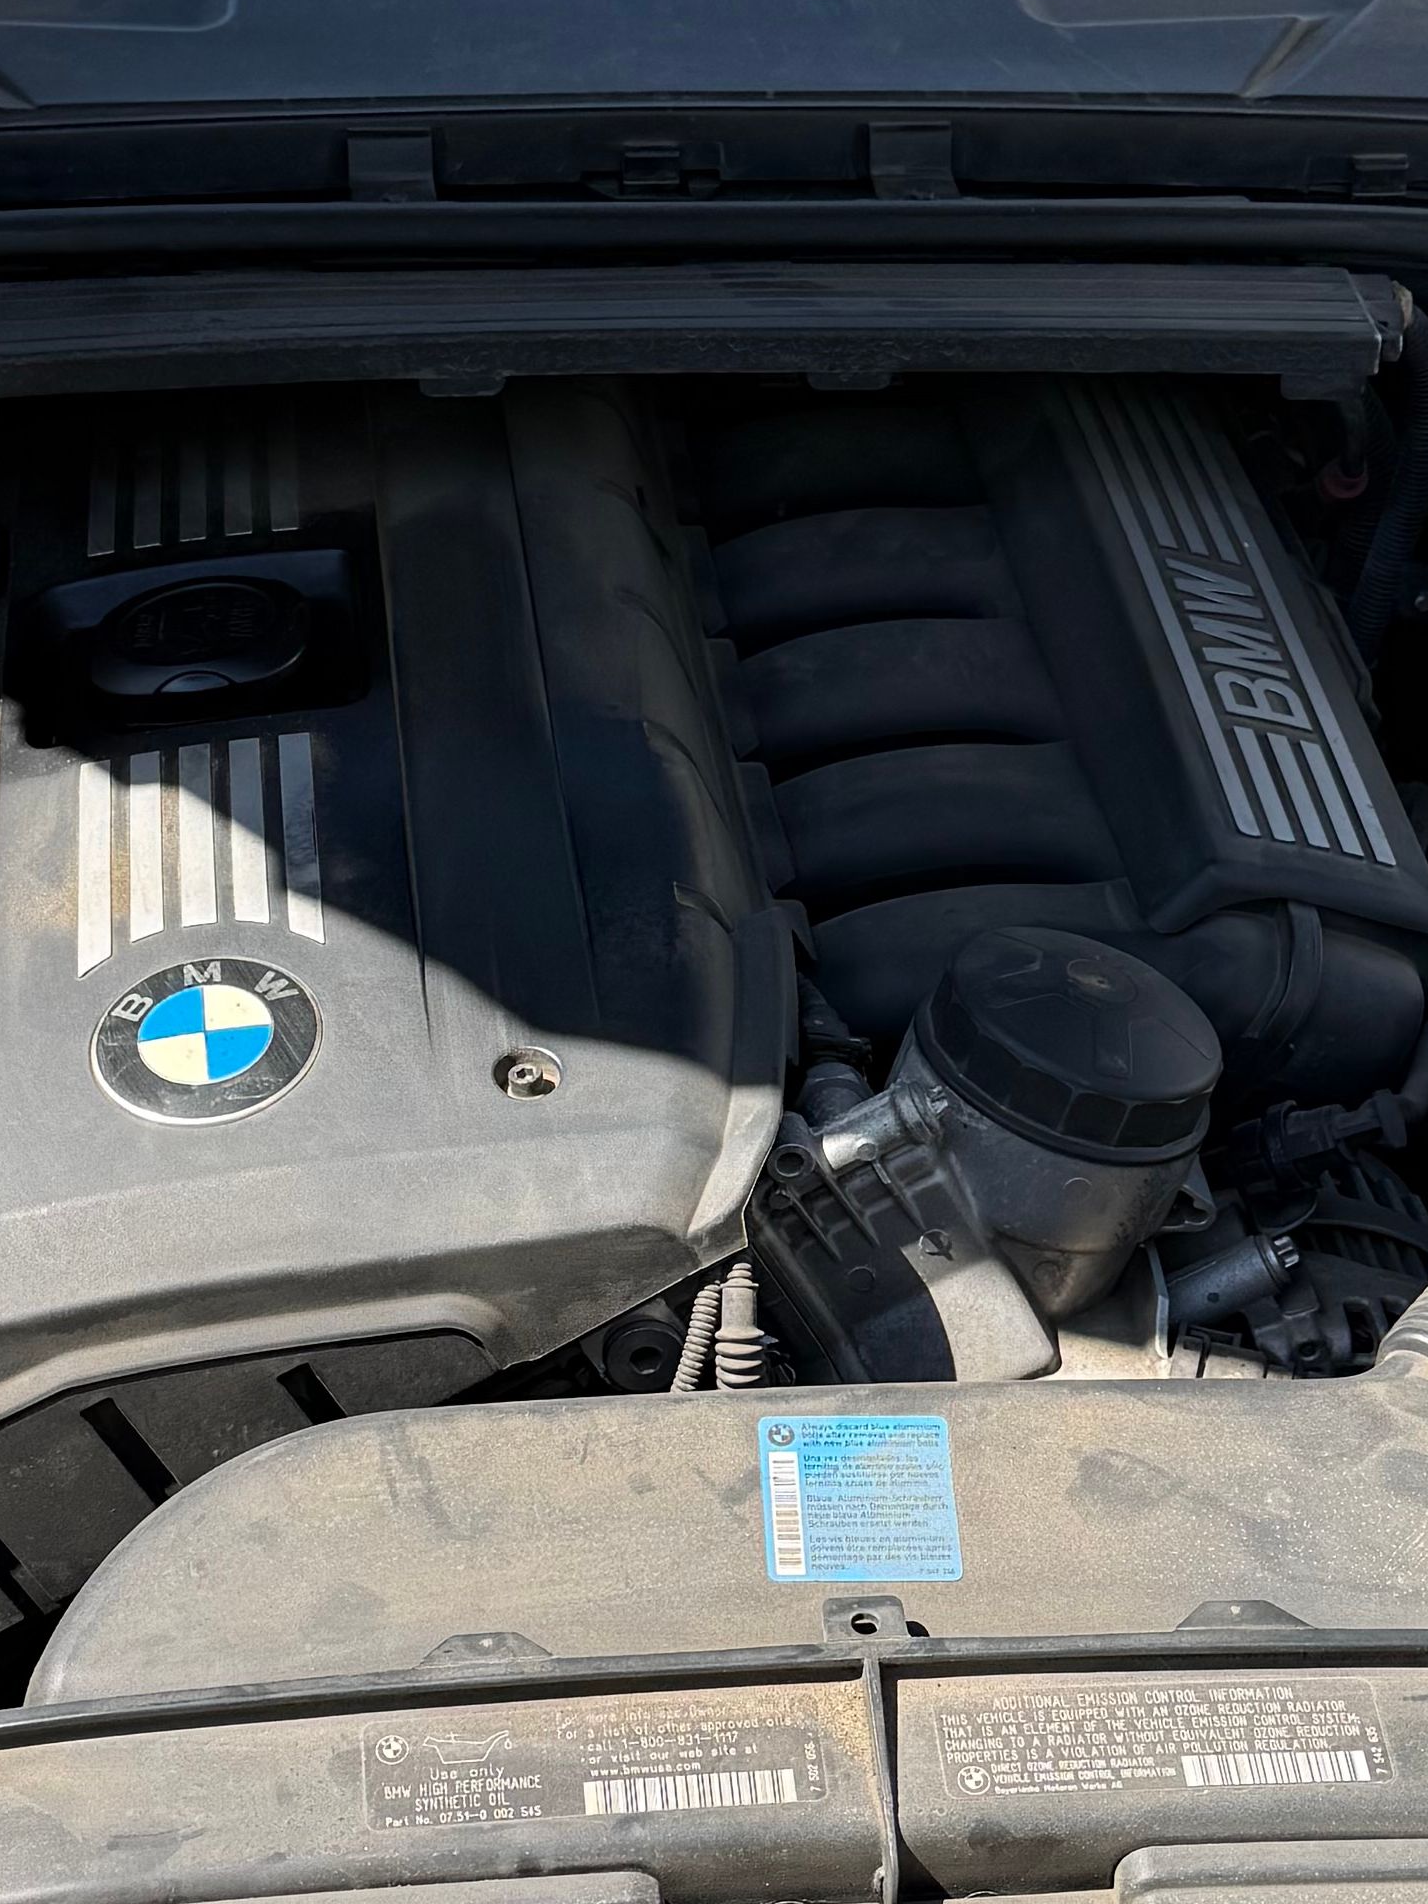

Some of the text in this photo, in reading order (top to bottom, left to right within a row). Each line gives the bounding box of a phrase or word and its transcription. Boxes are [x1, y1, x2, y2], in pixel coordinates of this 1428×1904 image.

[1165, 558, 1313, 732] BMW
[111, 961, 300, 1022] BMW
[993, 1687, 1293, 1710] ADDITIONAL EMISSION CONTROL INFORMATION
[941, 1700, 1346, 1725] THIS VEHICLE IS EQUIPPED WITH AN OZONE REDUCTION RADIATOR
[943, 1727, 973, 1738] THAT
[982, 1725, 993, 1736] IS
[1001, 1724, 1017, 1735] AN
[1024, 1722, 1075, 1734] ELEMENT
[1084, 1721, 1097, 1732] OF
[1105, 1719, 1126, 1730] THE
[1135, 1717, 1184, 1729] VEHICLE
[1192, 1716, 1247, 1728] EMISSION
[1254, 1714, 1306, 1726] CONTROL
[944, 1725, 1360, 1751] CHANGING TO A RADIATOR WITHOUT EQUIVALENT OZONE REDUCTION
[588, 1742, 612, 1752] call
[946, 1750, 1019, 1764] PROPERTIES
[1026, 1750, 1038, 1760] IS
[1046, 1749, 1054, 1758] A
[1061, 1745, 1126, 1759] VIOLATION
[1133, 1744, 1146, 1755] OF
[1156, 1743, 1175, 1754] AIR
[1183, 1740, 1248, 1753] POLLUTION
[430, 1764, 504, 1780] Use only
[384, 1775, 542, 1799] BMW HIGH PERFORMANCE
[415, 1792, 510, 1812] SYNTHETIC OIL
